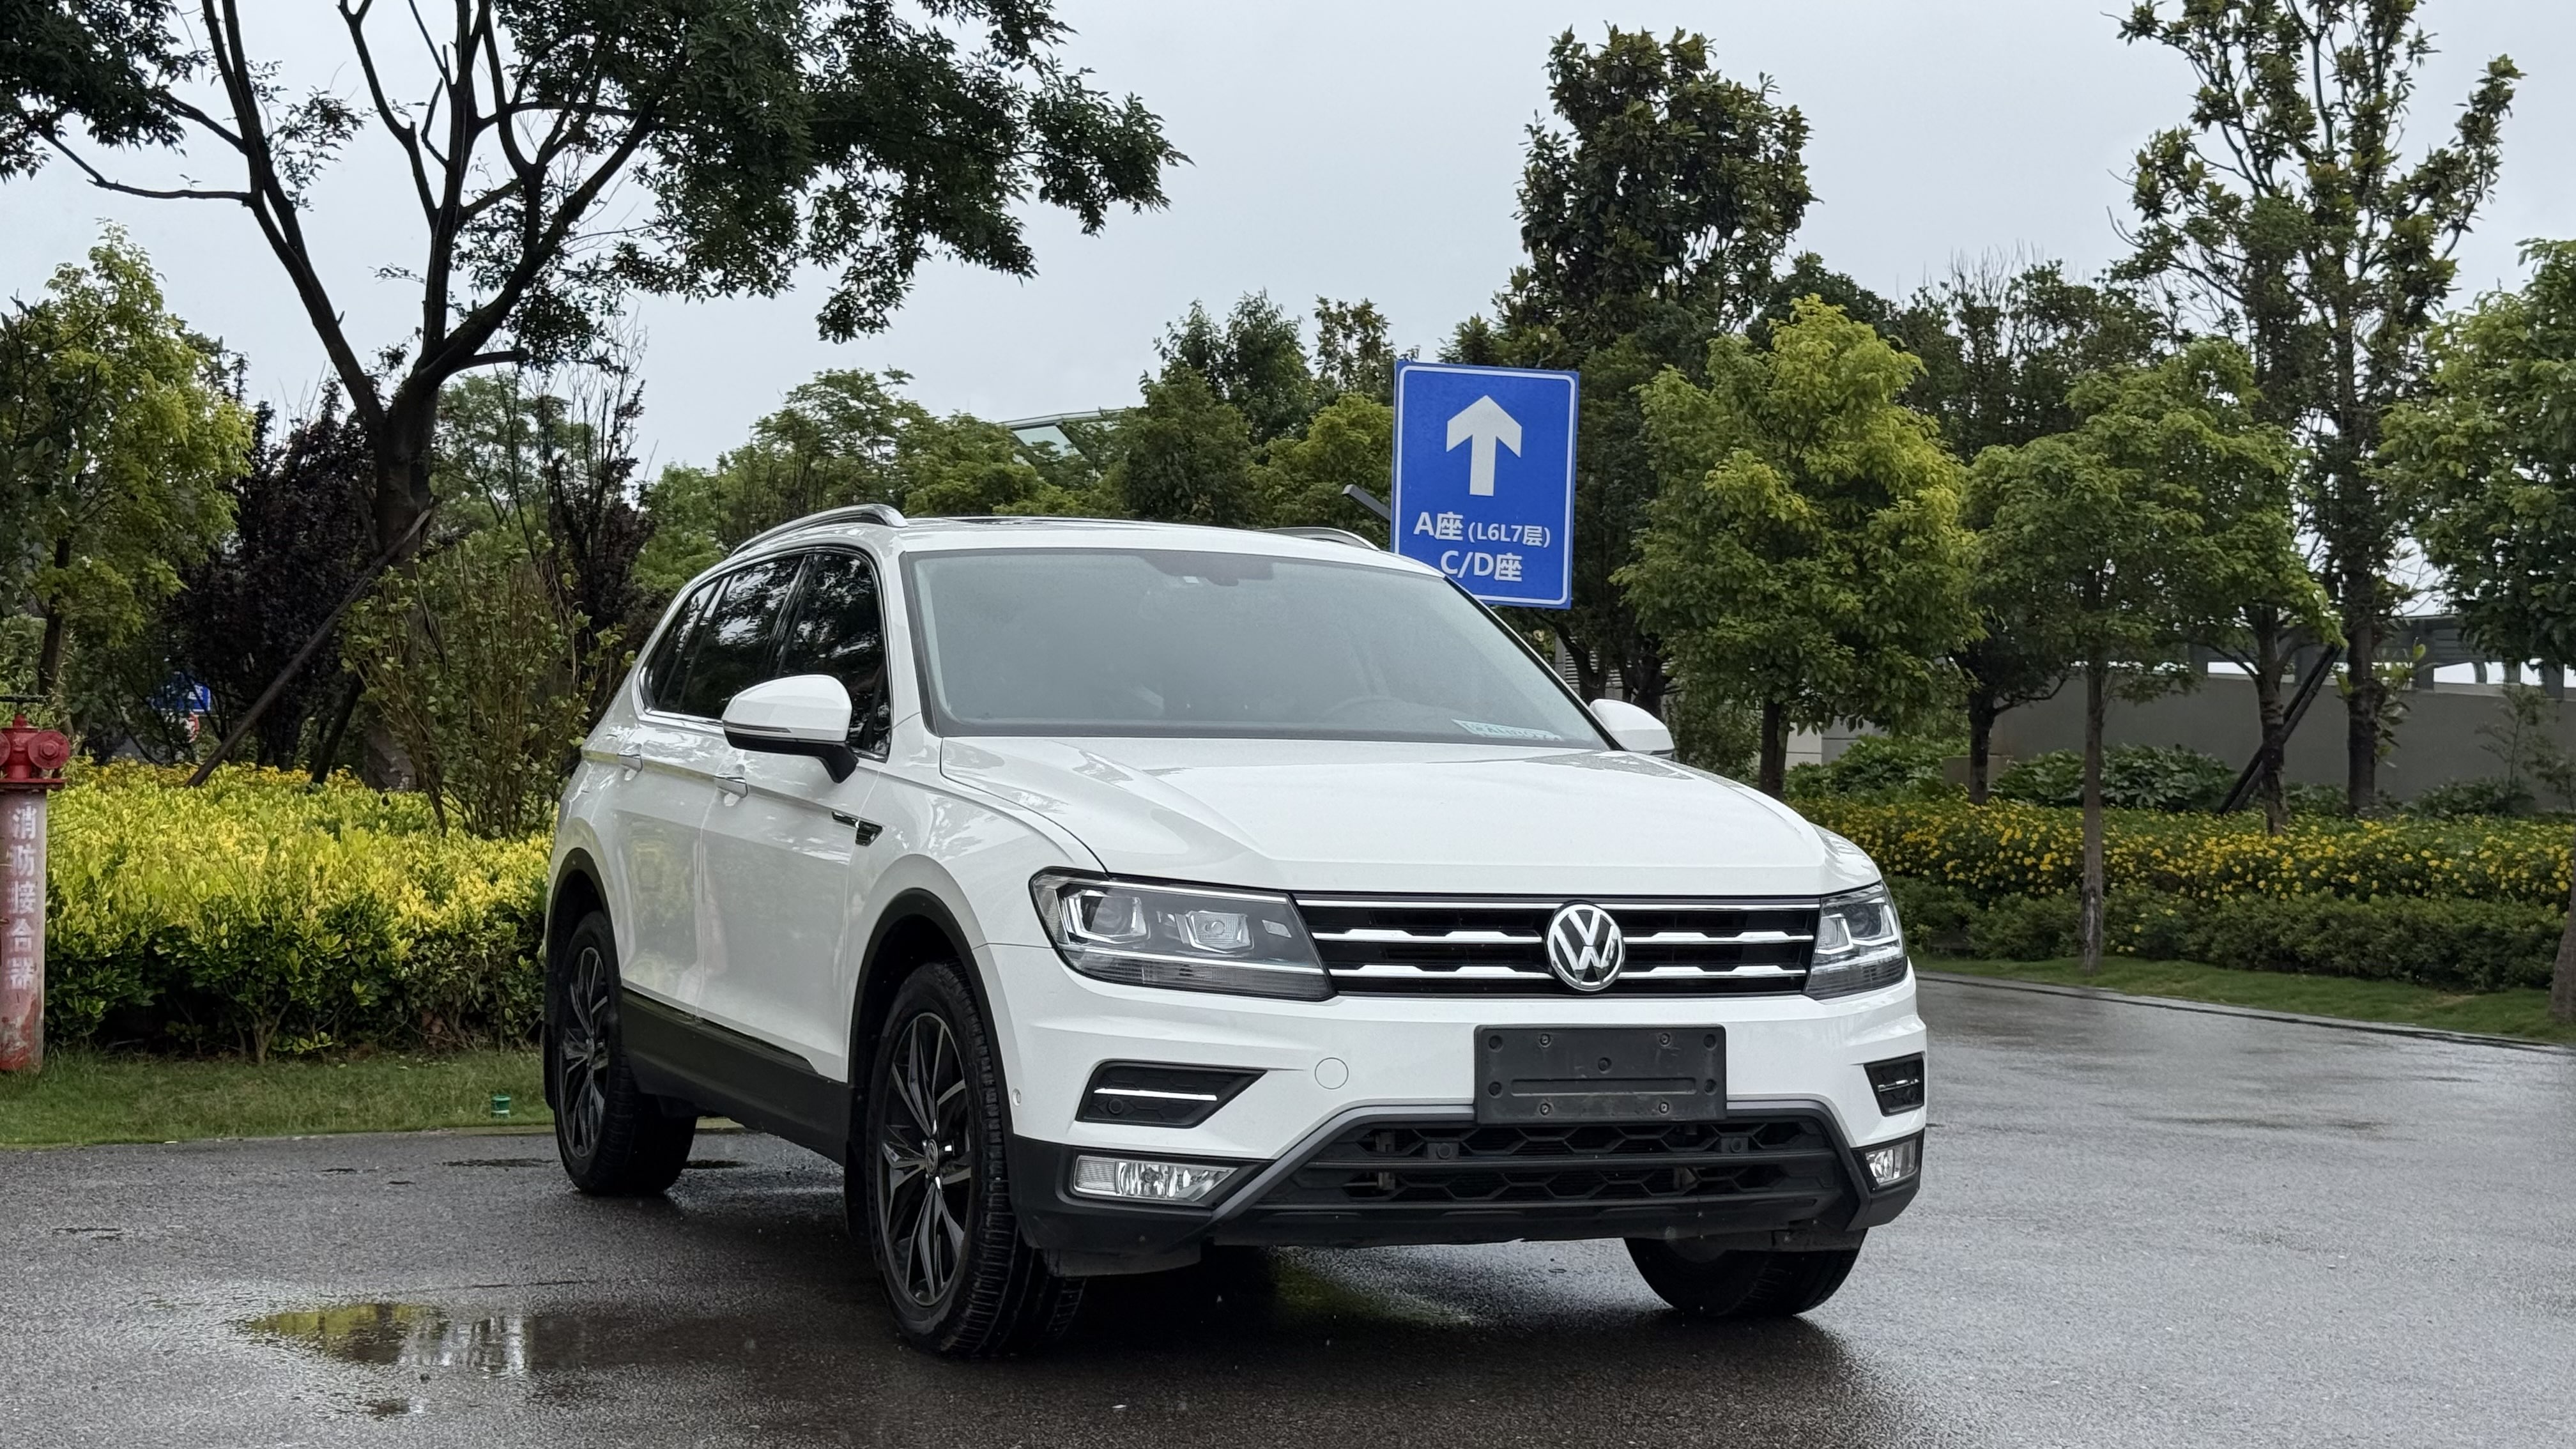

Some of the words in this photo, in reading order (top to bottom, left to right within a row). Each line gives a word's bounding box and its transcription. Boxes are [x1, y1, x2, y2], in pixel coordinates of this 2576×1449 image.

[1413, 511, 1464, 540] A座
[1468, 521, 1551, 548] (L6L7层)
[1440, 550, 1522, 582] C/D座
[8, 805, 37, 990] 消防接合器
[1547, 904, 1623, 990] VW
